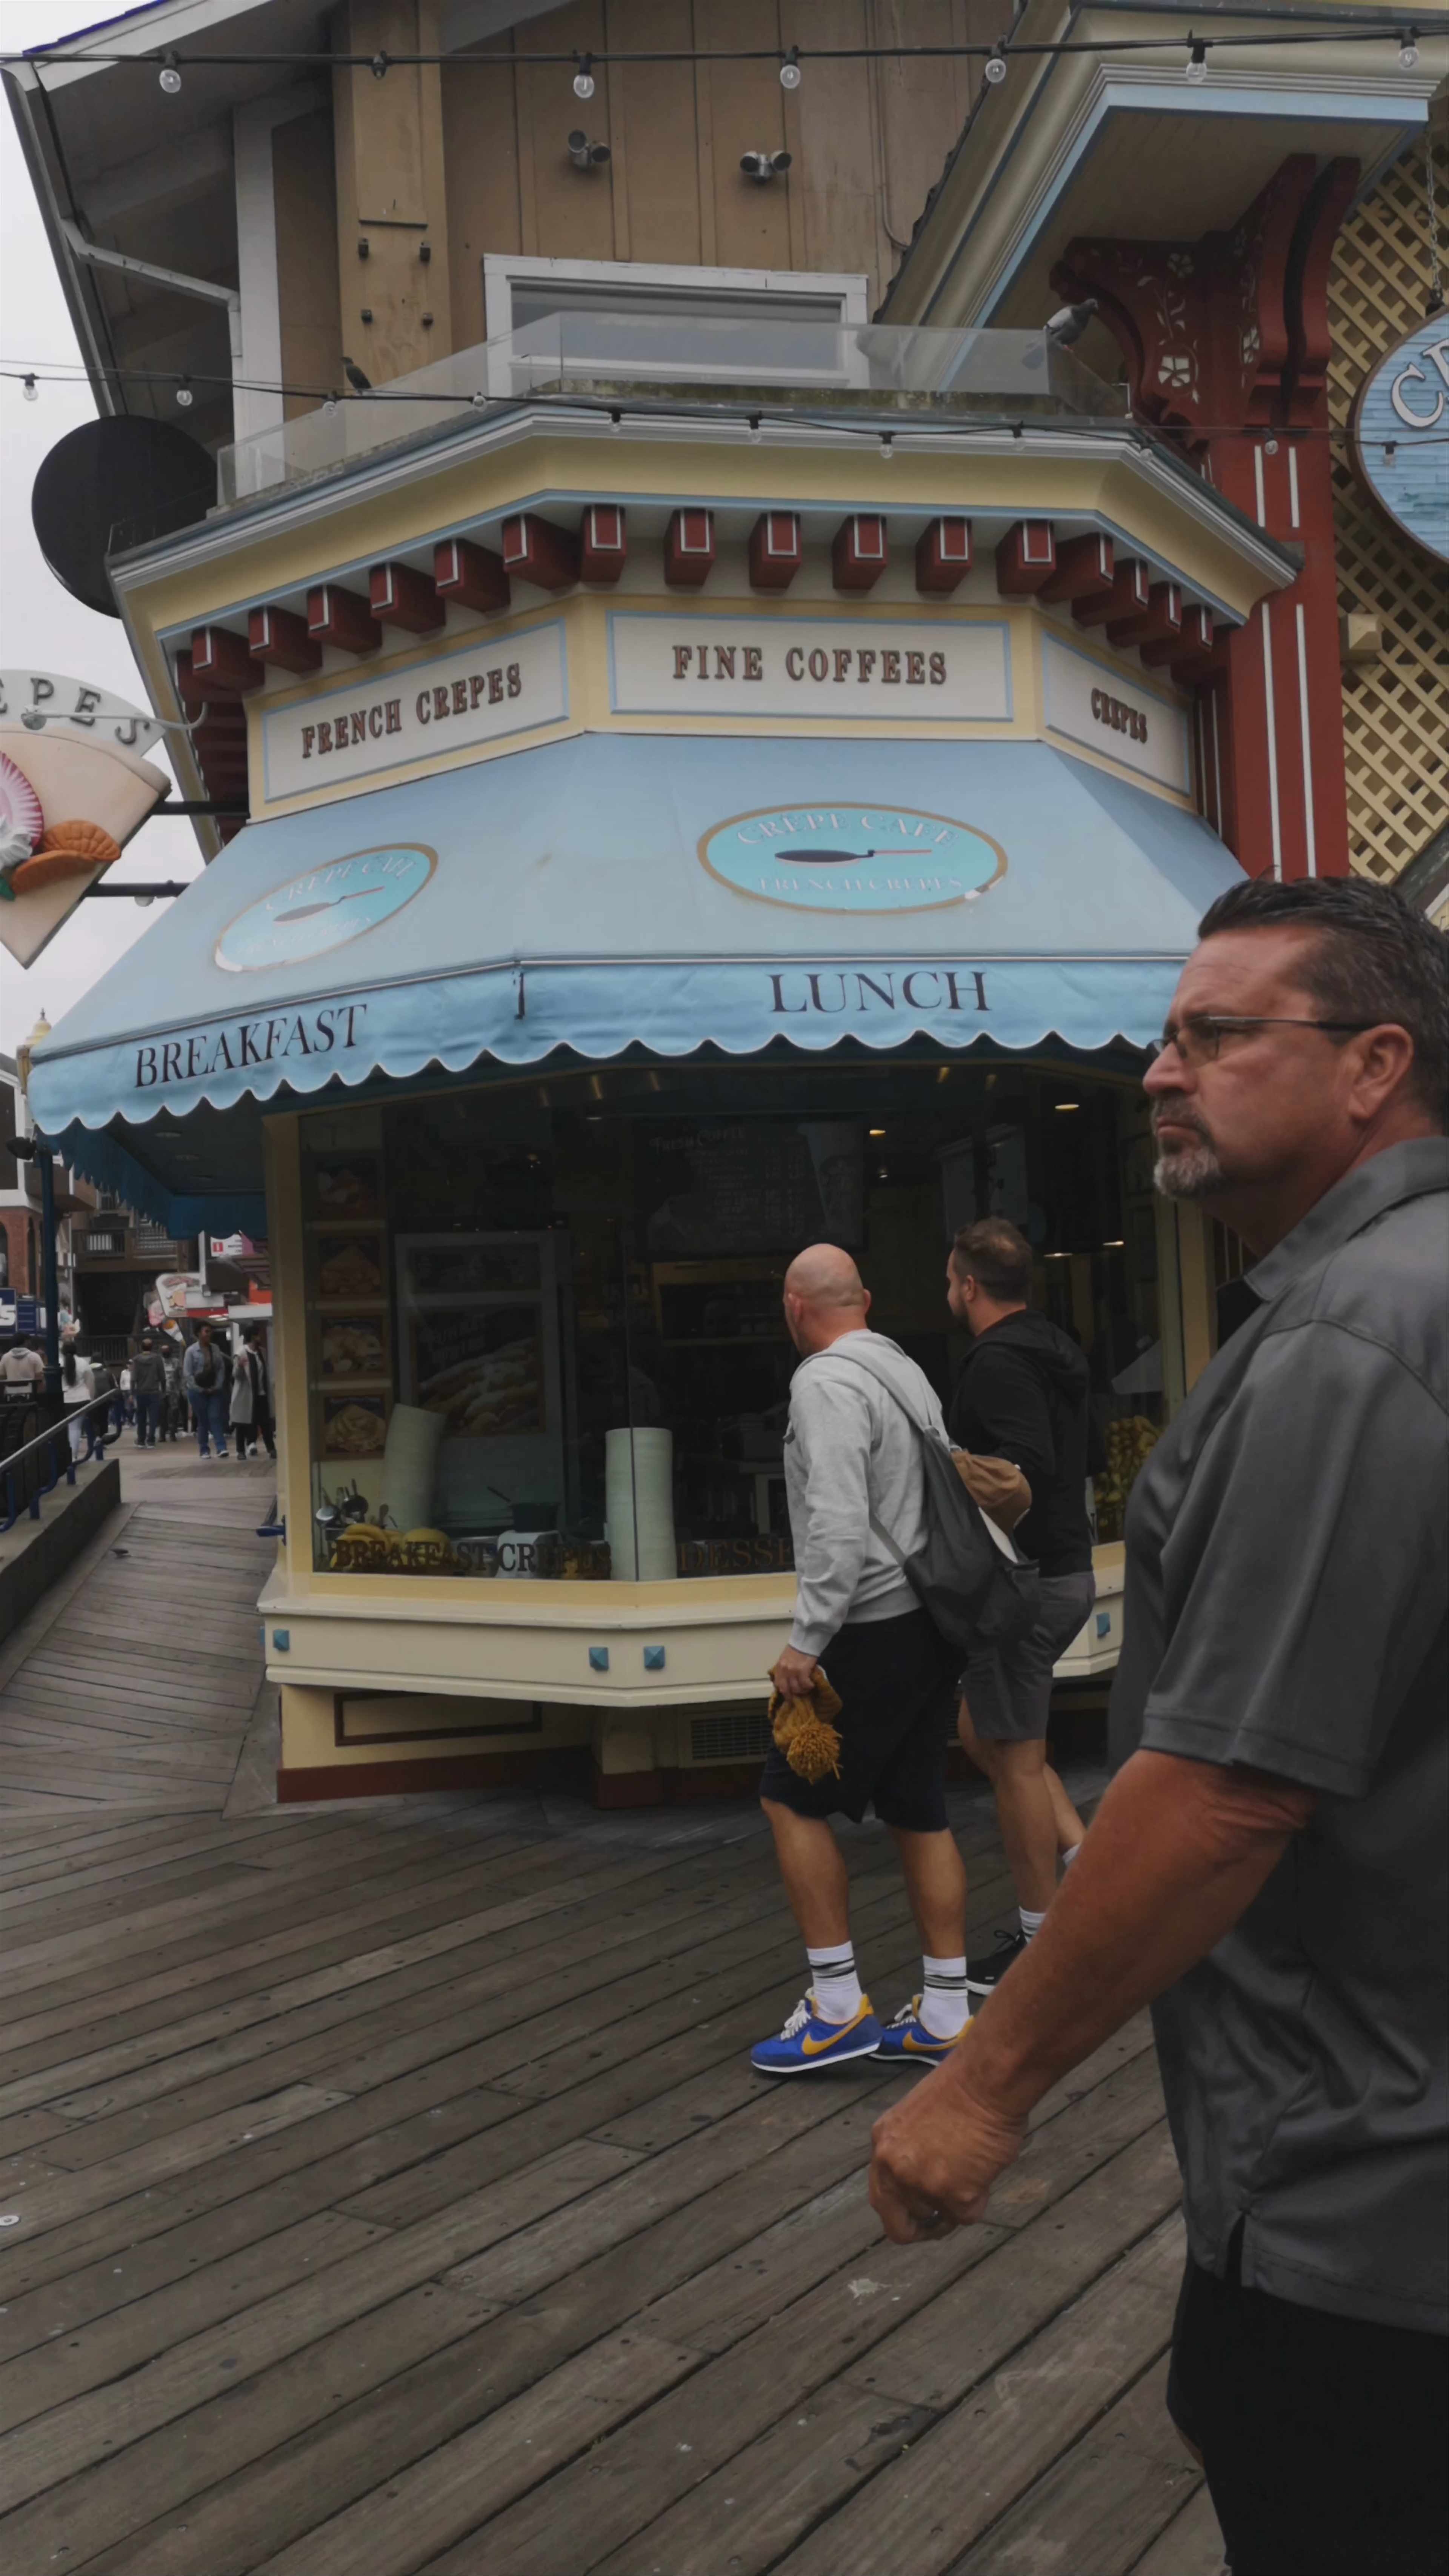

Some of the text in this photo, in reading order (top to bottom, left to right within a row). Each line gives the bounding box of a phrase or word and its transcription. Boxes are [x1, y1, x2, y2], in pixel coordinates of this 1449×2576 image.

[672, 645, 947, 685] FINE COFFEES
[301, 663, 522, 758] FRENCH CREPES
[1091, 687, 1148, 744] CREPES
[765, 970, 992, 1013] LUNCH
[134, 1004, 367, 1088] BREAKFAST
[334, 1540, 612, 1575] BREAKFAST CREPES
